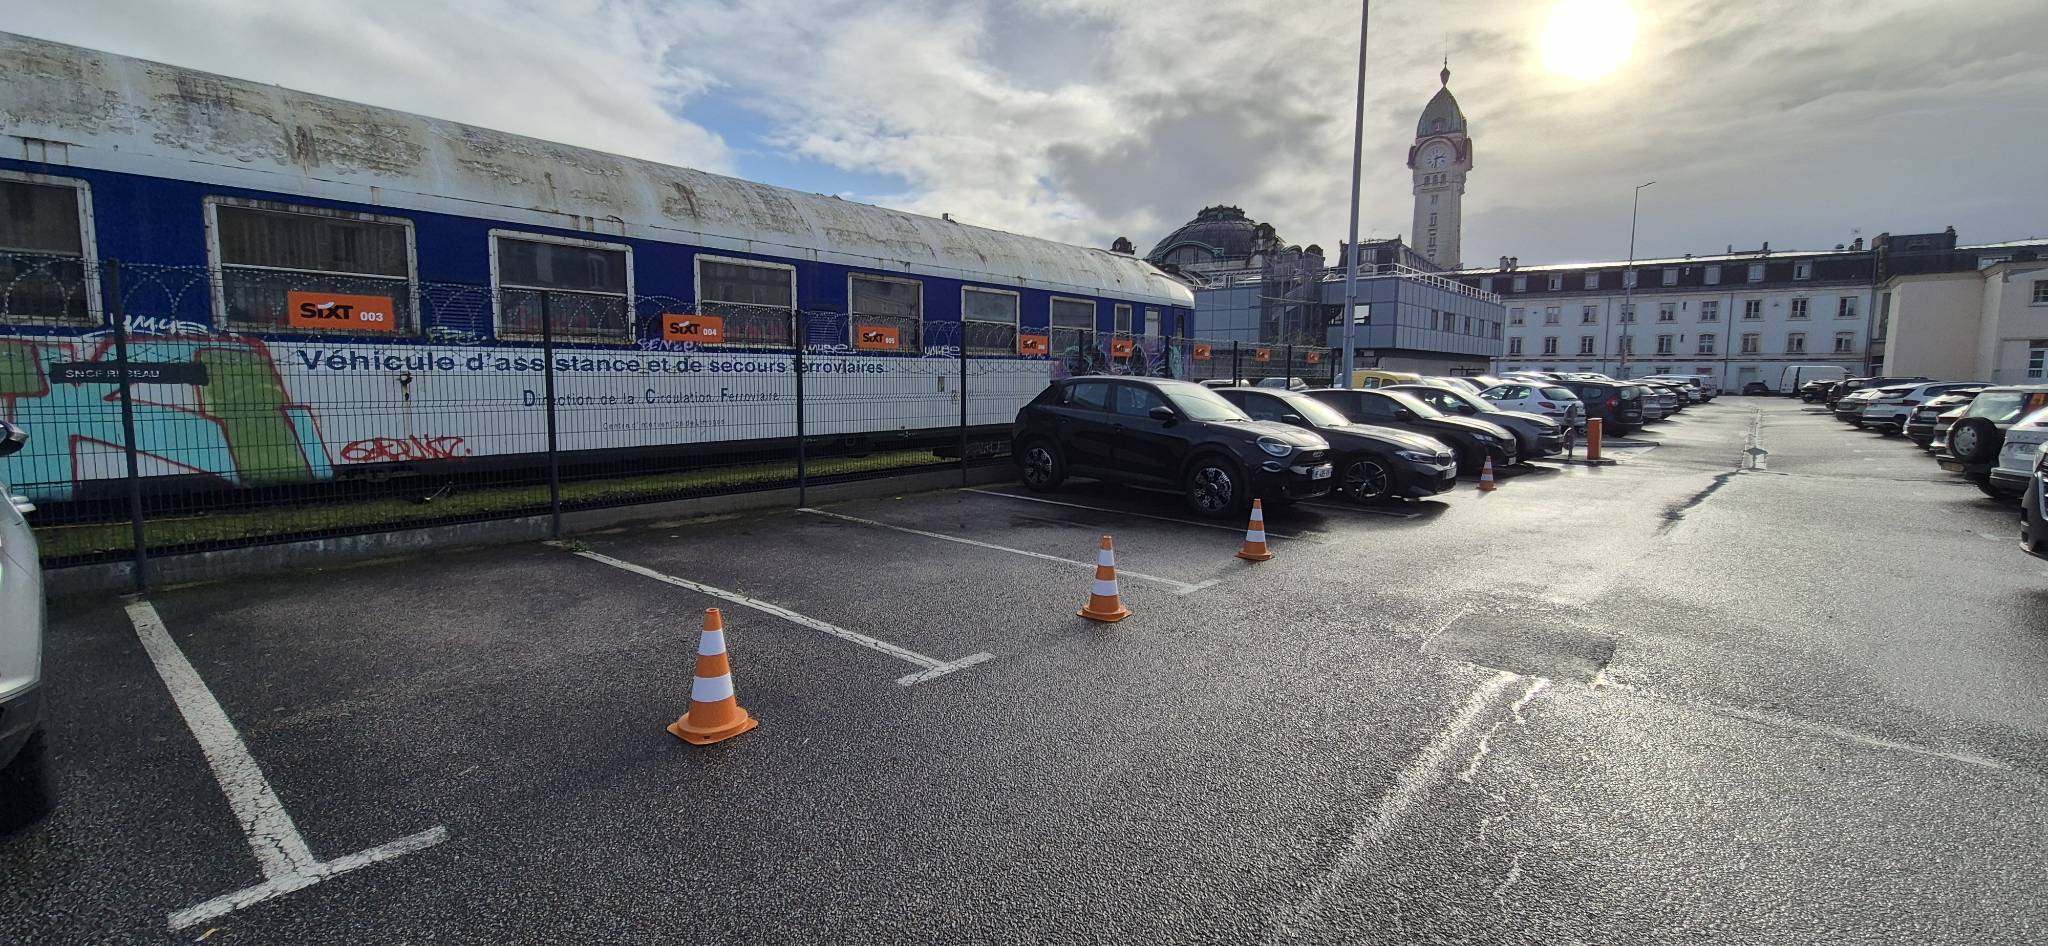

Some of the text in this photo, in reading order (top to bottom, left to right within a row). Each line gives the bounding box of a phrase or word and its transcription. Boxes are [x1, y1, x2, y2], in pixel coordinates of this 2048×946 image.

[360, 311, 384, 322] 003
[703, 328, 717, 336] 004
[298, 349, 455, 371] Véhicule
[466, 353, 639, 372] d'assstance
[647, 359, 669, 373] et
[677, 358, 702, 373] de
[709, 359, 786, 373] secours
[65, 369, 101, 378] SNCF
[600, 394, 616, 405] de
[624, 393, 635, 405] la
[645, 389, 711, 404] Circulation
[720, 387, 779, 403] Ferroviaire
